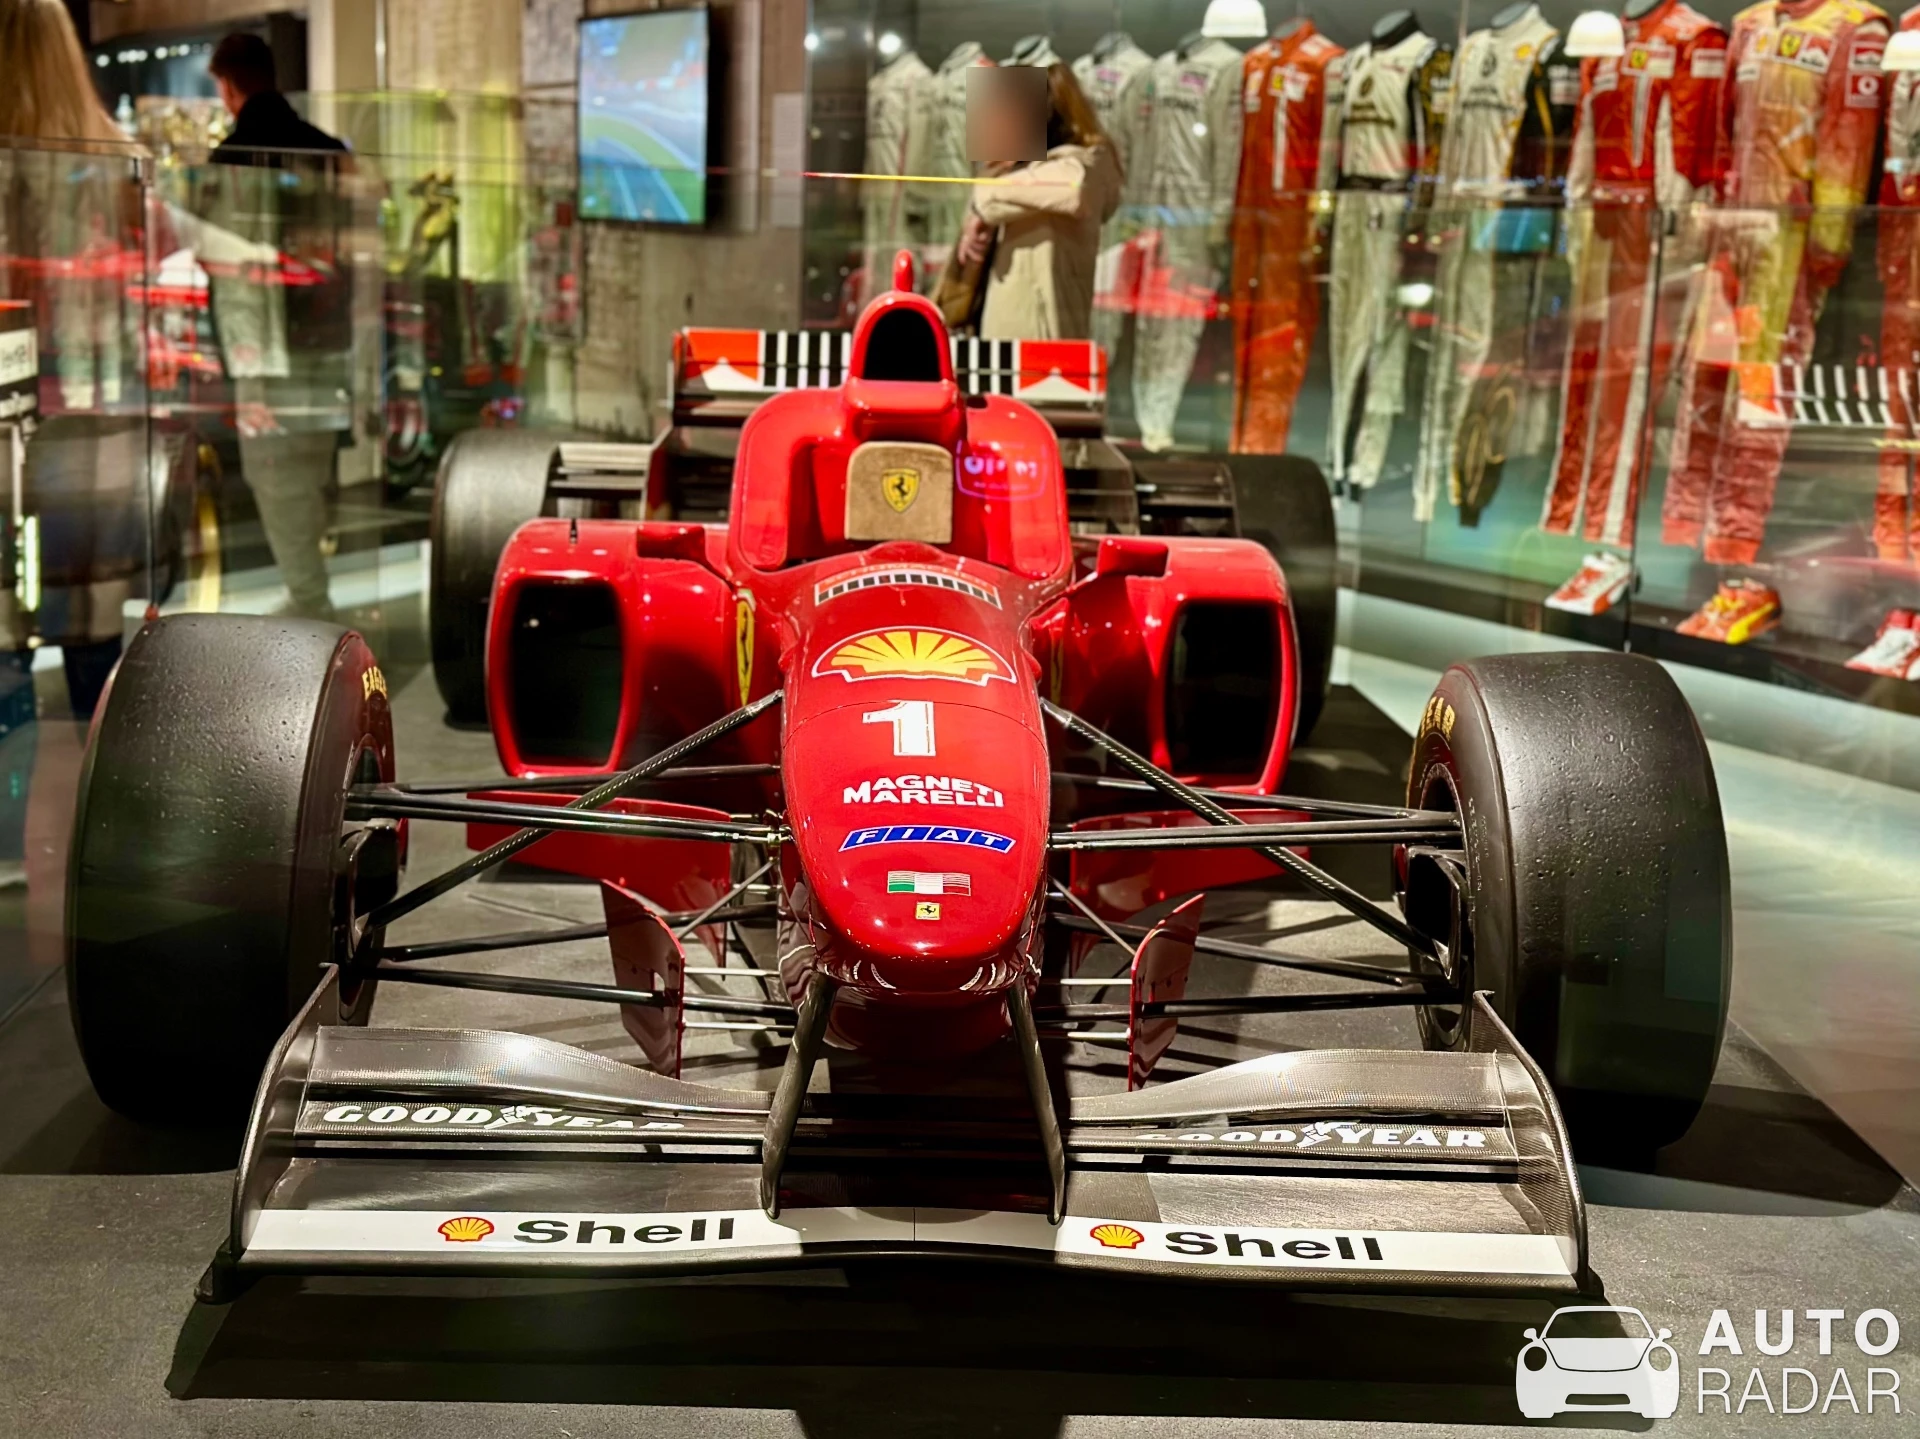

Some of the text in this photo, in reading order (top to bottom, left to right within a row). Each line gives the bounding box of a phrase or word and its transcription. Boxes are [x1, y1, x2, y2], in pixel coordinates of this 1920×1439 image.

[862, 700, 937, 757] 1
[843, 775, 1004, 801] MAGNETI
[843, 784, 1004, 808] MARELLI
[854, 829, 1004, 848] FIAT
[513, 1217, 735, 1245] Shell
[1165, 1230, 1384, 1263] Shell
